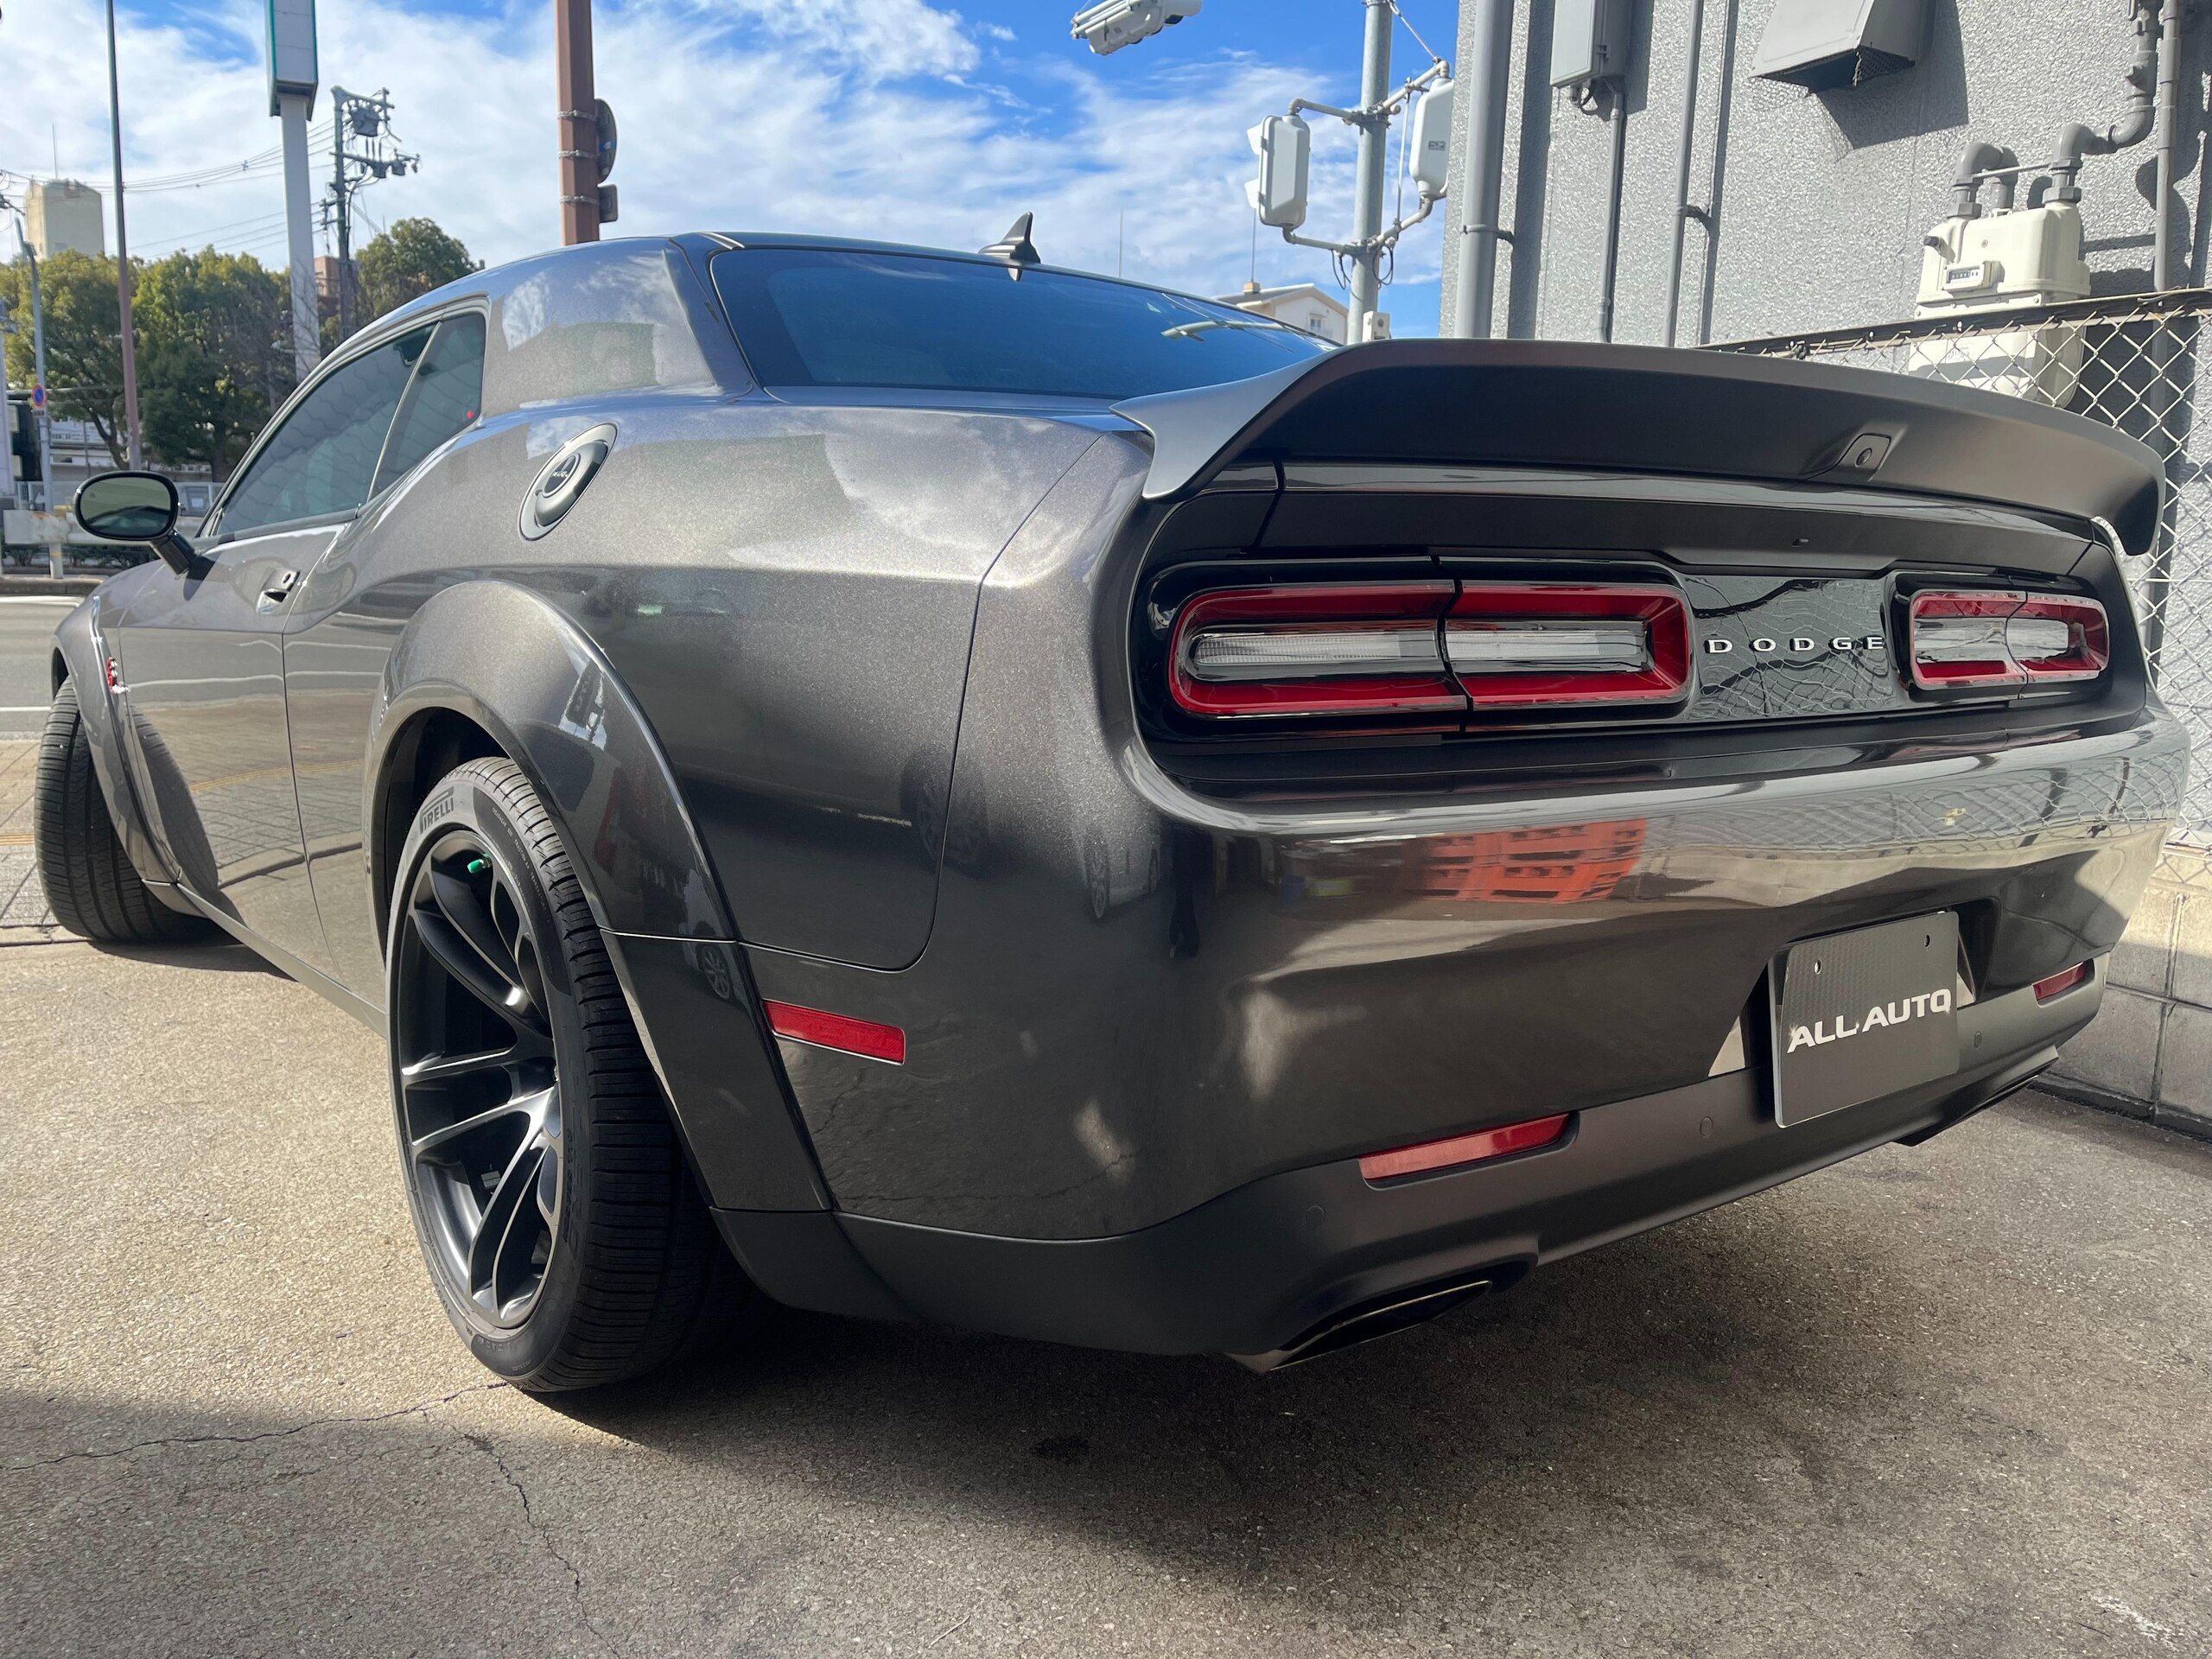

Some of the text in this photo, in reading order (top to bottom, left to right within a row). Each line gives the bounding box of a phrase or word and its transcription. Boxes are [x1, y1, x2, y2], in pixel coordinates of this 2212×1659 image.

[1704, 634, 1886, 654] DODGE
[419, 786, 454, 836] PIRELLI
[1787, 988, 1953, 1054] ALL AUTO
